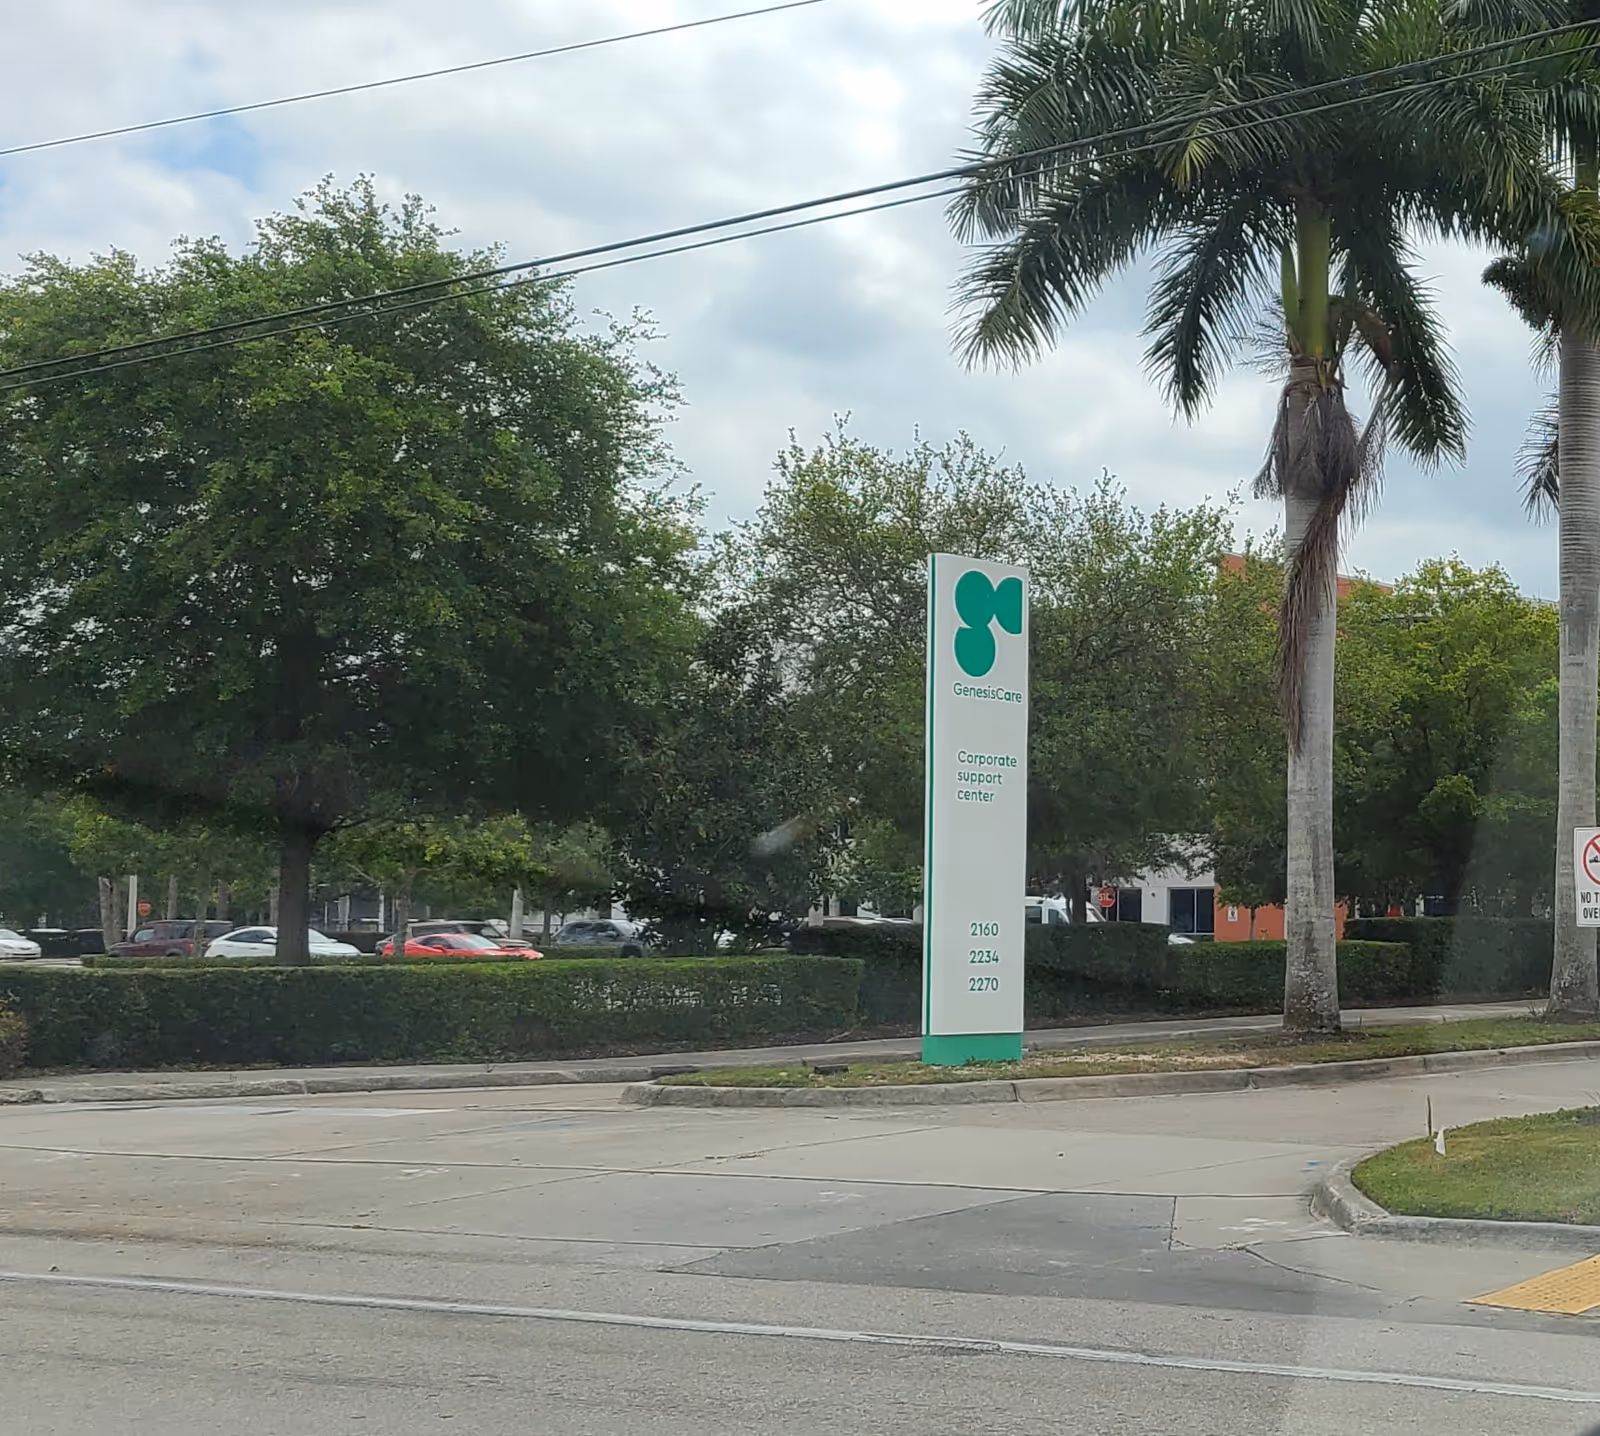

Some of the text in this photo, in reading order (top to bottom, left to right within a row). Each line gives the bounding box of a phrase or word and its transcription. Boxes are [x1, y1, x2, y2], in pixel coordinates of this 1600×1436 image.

[953, 682, 1022, 703] GenesisCare
[958, 750, 1017, 767] Corporate
[957, 771, 1003, 786] support
[957, 789, 995, 802] center
[1580, 891, 1591, 904] NO
[1582, 907, 1600, 919] OVE
[970, 922, 999, 936] 2160
[969, 950, 999, 963] 2234
[968, 977, 999, 991] 2270
